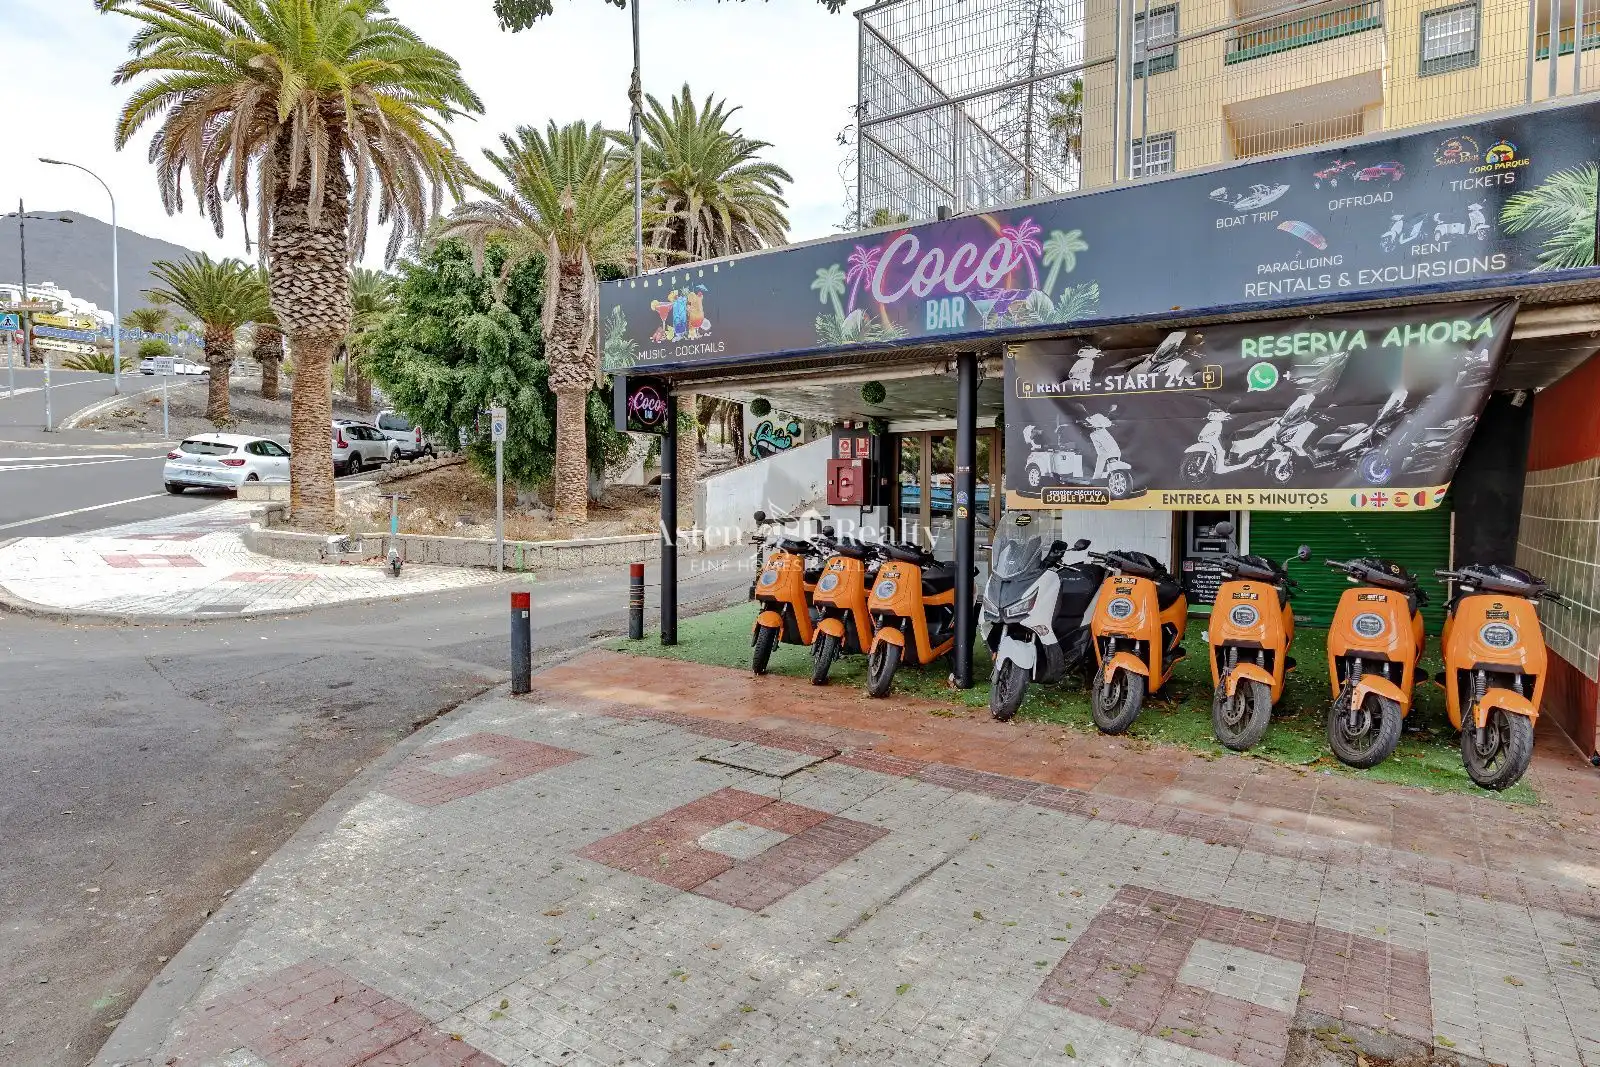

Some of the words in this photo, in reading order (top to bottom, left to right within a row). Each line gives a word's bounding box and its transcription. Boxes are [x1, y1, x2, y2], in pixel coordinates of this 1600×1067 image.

[1469, 164, 1493, 174] LORO
[1494, 158, 1530, 171] PARQUE
[1450, 172, 1515, 192] TICKETS
[1328, 191, 1394, 211] OFFROAD
[1216, 213, 1249, 229] BOAT
[1251, 210, 1279, 225] TRIP
[1411, 241, 1450, 256] RENT
[872, 233, 1023, 303] Coco
[1257, 254, 1343, 274] PARAGLIDING
[1245, 273, 1331, 298] RENTALS
[1338, 271, 1351, 287] &
[1358, 253, 1507, 286] EXCURSIONS
[926, 296, 965, 331] BAR
[1241, 329, 1367, 359] RESERVA
[1382, 319, 1494, 348] AHORA
[638, 348, 666, 361] MUSIC
[675, 341, 725, 357] COCKTAILS
[1072, 380, 1091, 391] ME
[1104, 373, 1159, 391] START
[633, 391, 661, 411] Coco
[1047, 494, 1076, 503] DOBLE
[1078, 494, 1107, 503] PLAZA
[1162, 493, 1220, 505] ENTREGA
[1225, 493, 1243, 505] EN
[1247, 493, 1255, 505] 5
[1259, 493, 1329, 505] MINUTOS
